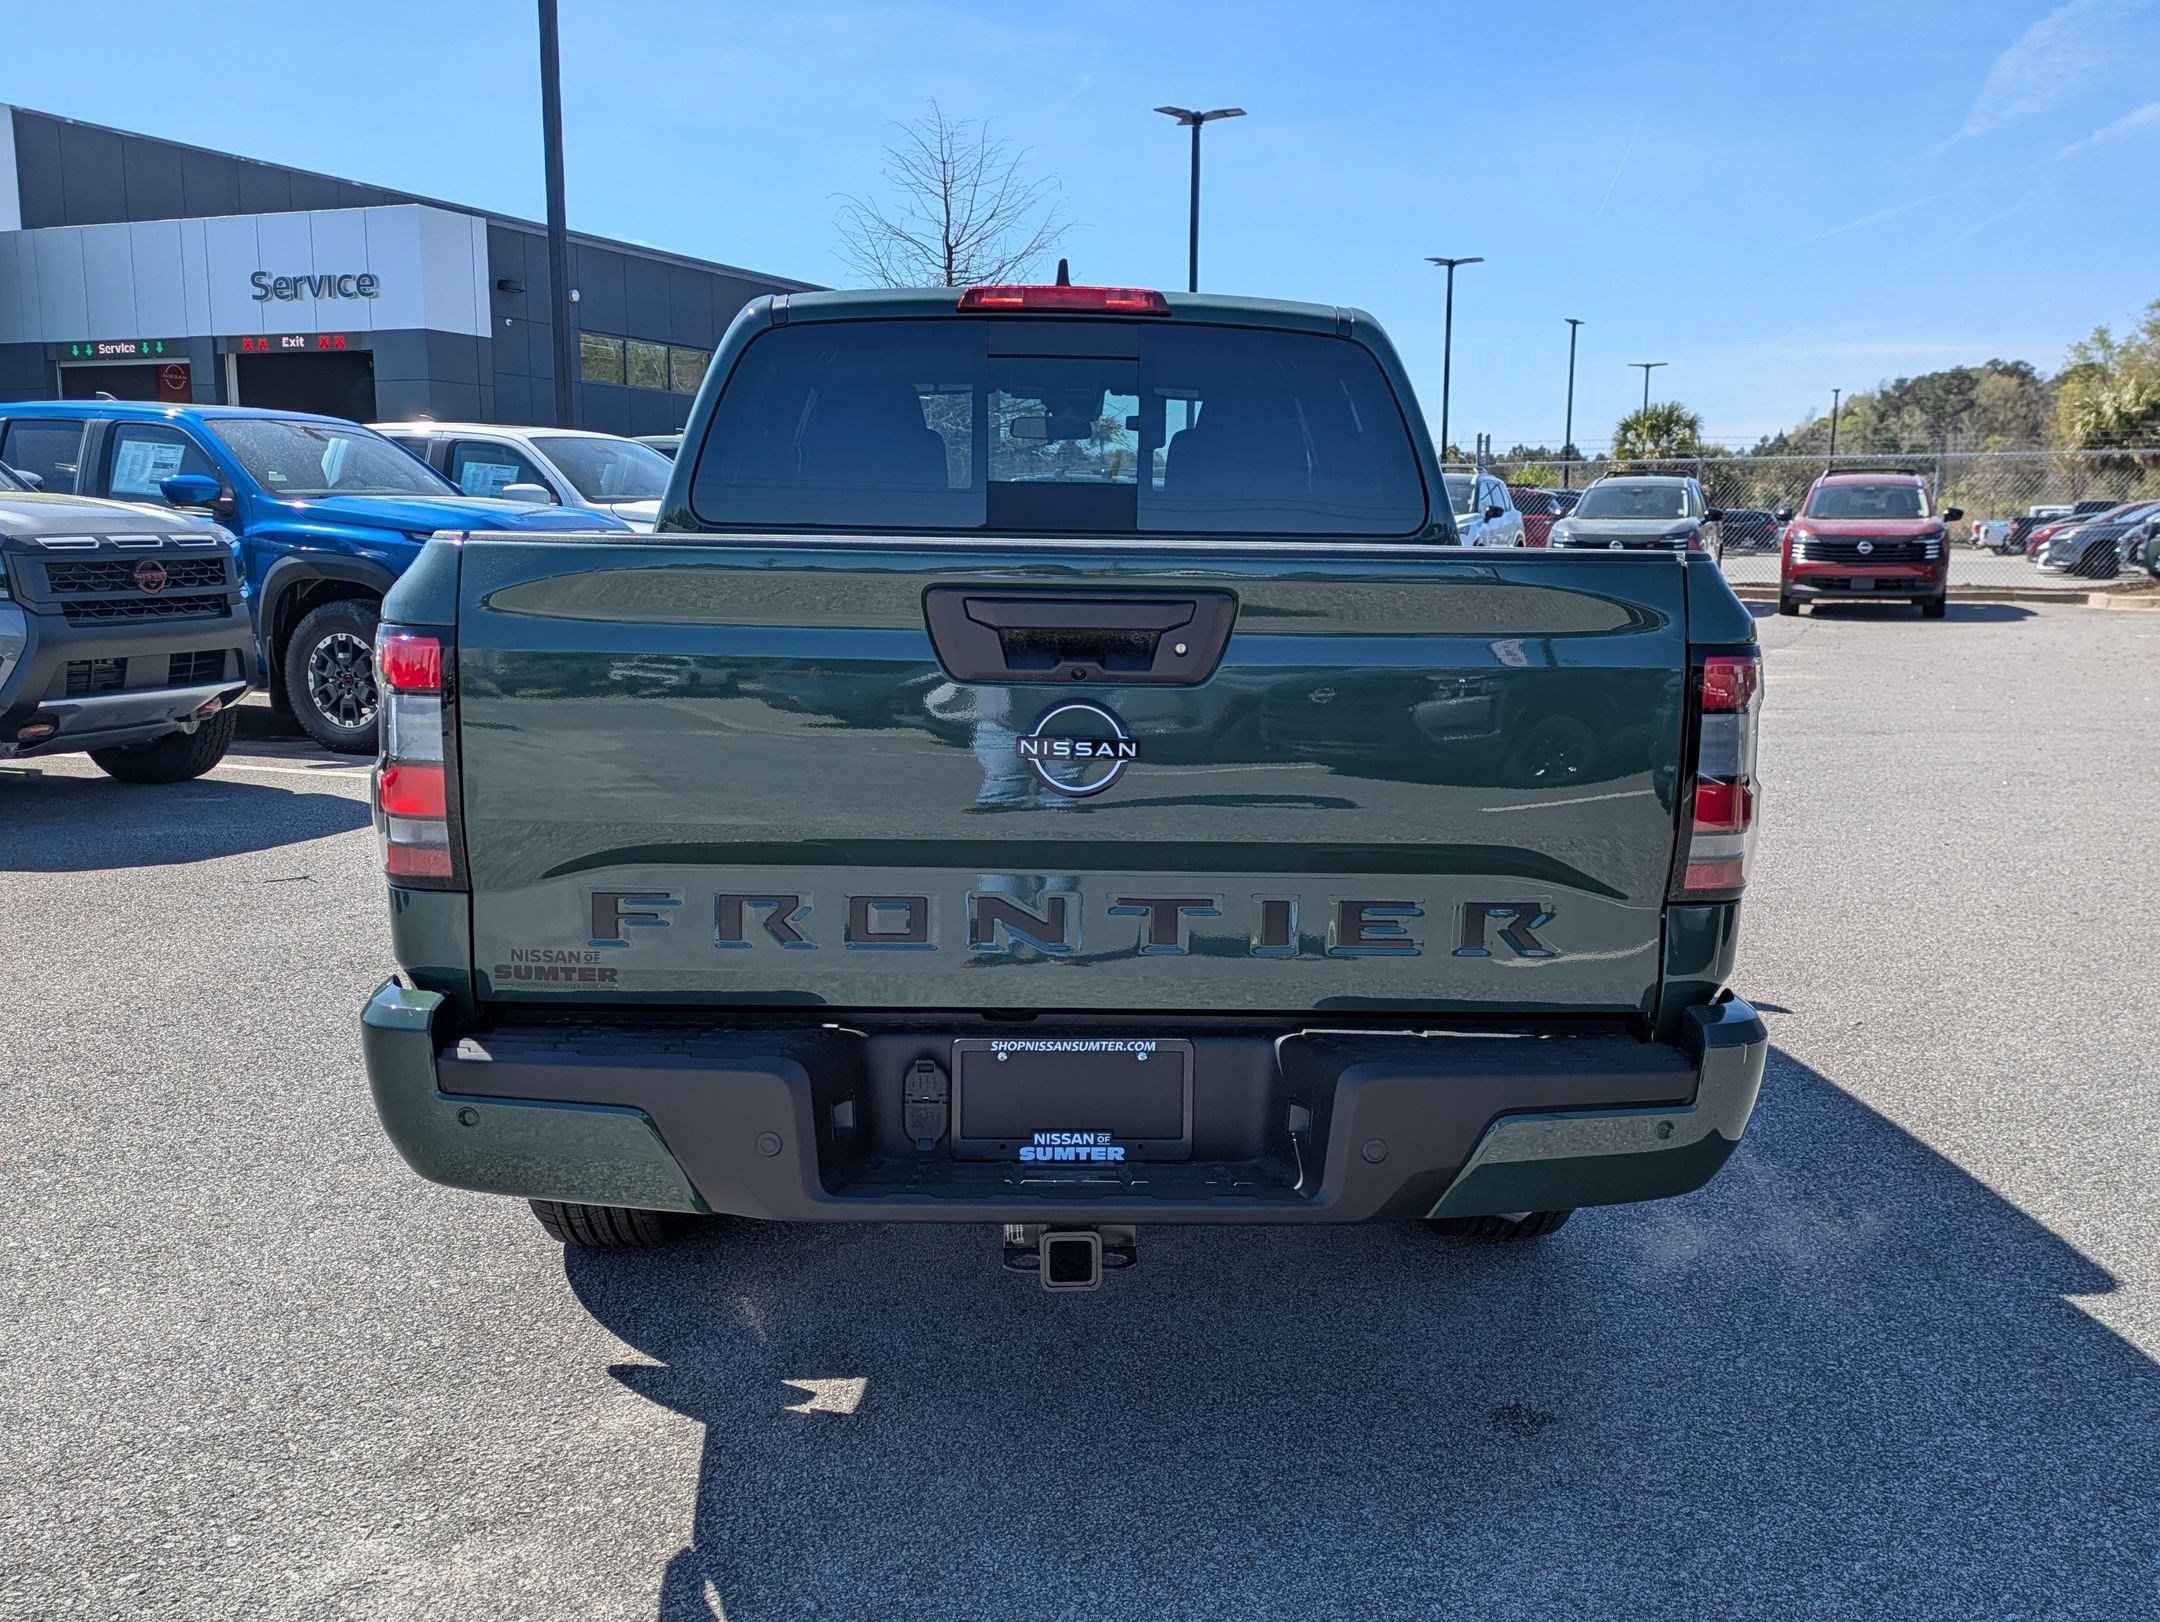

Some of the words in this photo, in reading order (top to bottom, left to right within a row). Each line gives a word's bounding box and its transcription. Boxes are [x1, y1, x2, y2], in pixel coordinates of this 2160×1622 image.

[250, 270, 379, 301] Service
[98, 342, 136, 355] Service
[281, 336, 305, 348] Exit
[1020, 740, 1137, 757] NISSAN
[591, 891, 1556, 957] FRONTIER
[510, 948, 581, 963] NISSAN
[584, 952, 600, 963] OF
[494, 964, 619, 982] SUMTER
[990, 1041, 1156, 1052] SHOPNISSANSUMTER.COM
[1034, 1133, 1095, 1145] NISSAN
[1097, 1134, 1111, 1145] OF
[1019, 1146, 1125, 1161] SUMTER
